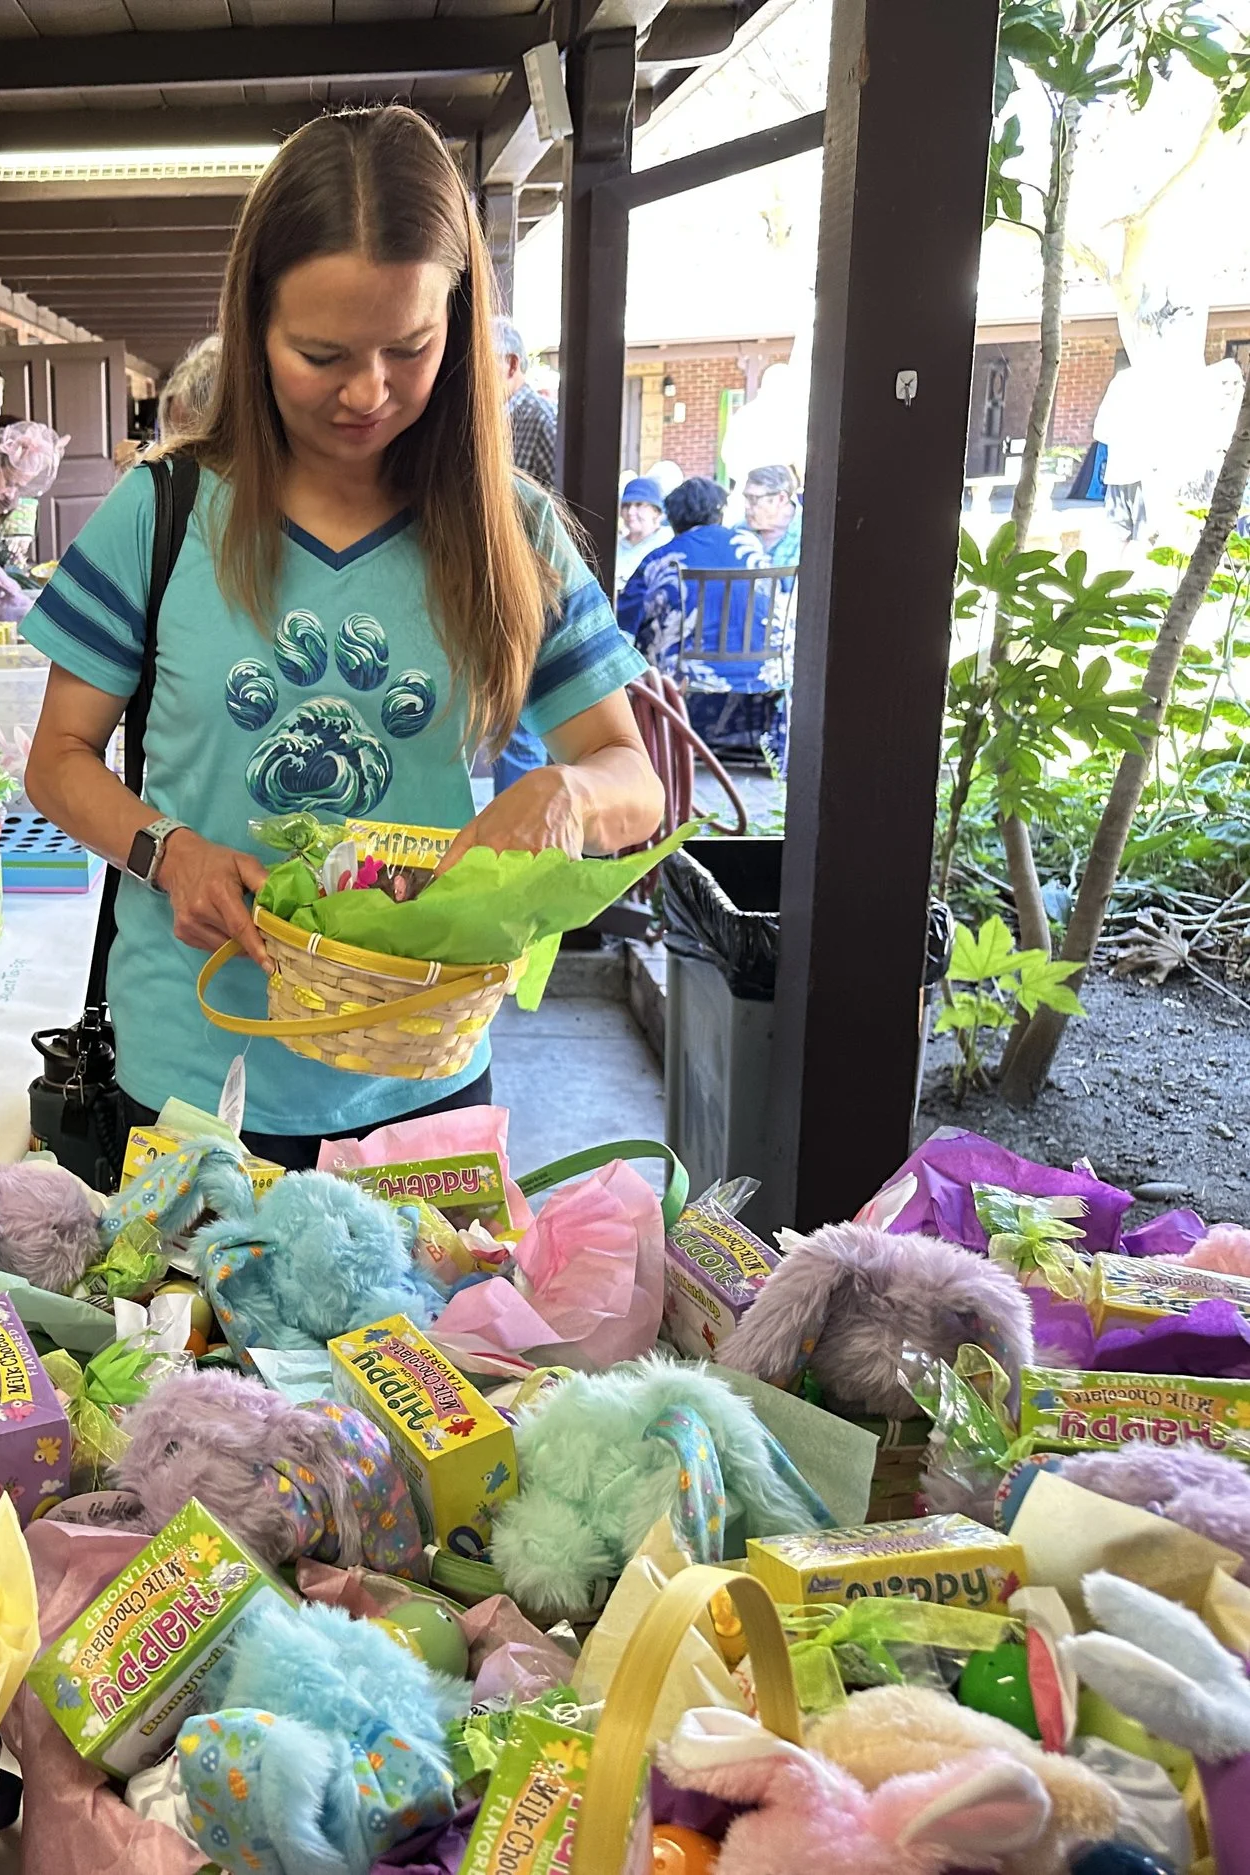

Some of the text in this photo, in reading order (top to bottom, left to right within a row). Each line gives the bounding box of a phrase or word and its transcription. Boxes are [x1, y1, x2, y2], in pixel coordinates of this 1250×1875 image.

[378, 1167, 480, 1200] Happy
[739, 1248, 765, 1271] Milk
[7, 1328, 39, 1377] FLAVORED
[388, 1341, 441, 1386] Chocolate
[418, 1347, 466, 1392] FLAVORED
[5, 1366, 27, 1395] Milk
[350, 1349, 436, 1431] Hippy
[397, 1366, 424, 1392] HOLLOW
[432, 1382, 461, 1412] Milk
[1072, 1387, 1215, 1414] Milk Chocolate
[1096, 1375, 1188, 1391] FLAVORED
[1057, 1409, 1227, 1450] Happy
[79, 1555, 187, 1669] Milk Chocolate
[83, 1558, 152, 1631] FLAVORED
[120, 1607, 159, 1649] HOLLOW
[88, 1583, 223, 1722] Happy
[140, 1677, 199, 1737] Bunny
[514, 1776, 559, 1832] Milk
